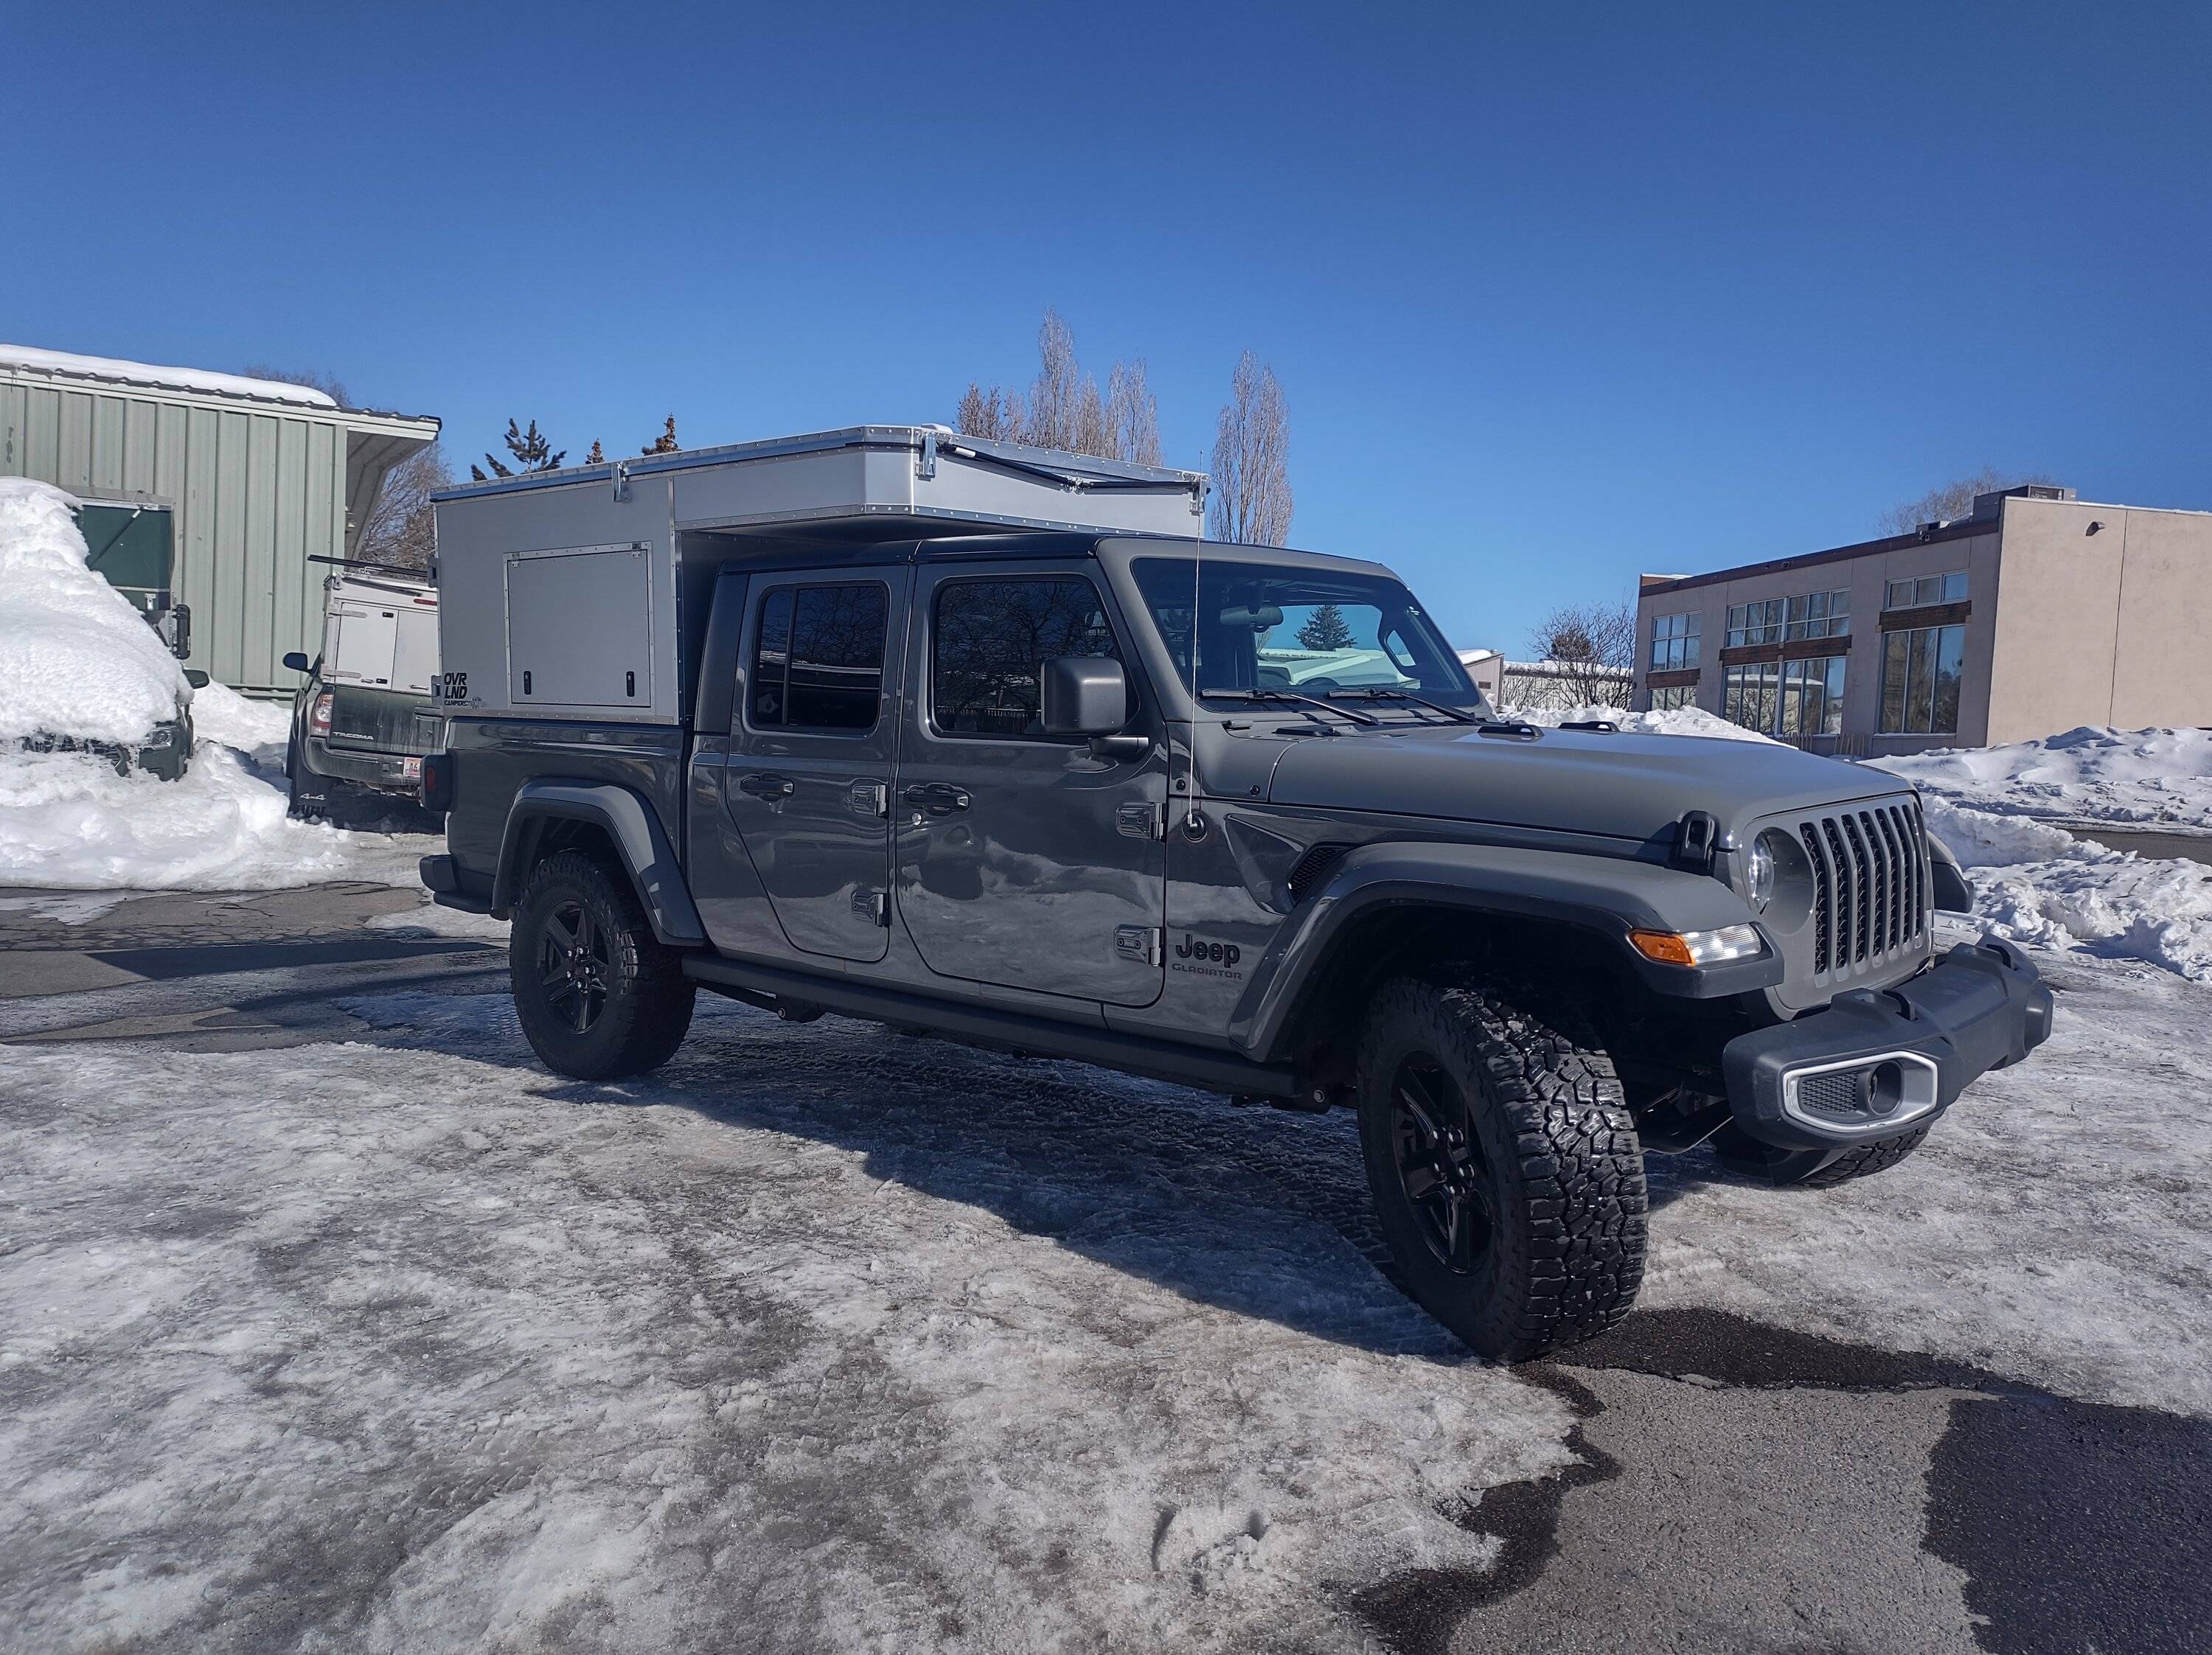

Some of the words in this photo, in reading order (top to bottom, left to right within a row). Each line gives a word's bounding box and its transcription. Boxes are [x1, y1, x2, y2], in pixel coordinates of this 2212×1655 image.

[444, 672, 467, 686] OVR
[445, 686, 467, 699] LND
[333, 731, 374, 740] TACOMA
[1175, 934, 1240, 968] Jeep
[1172, 964, 1243, 980] GLADIATOR
